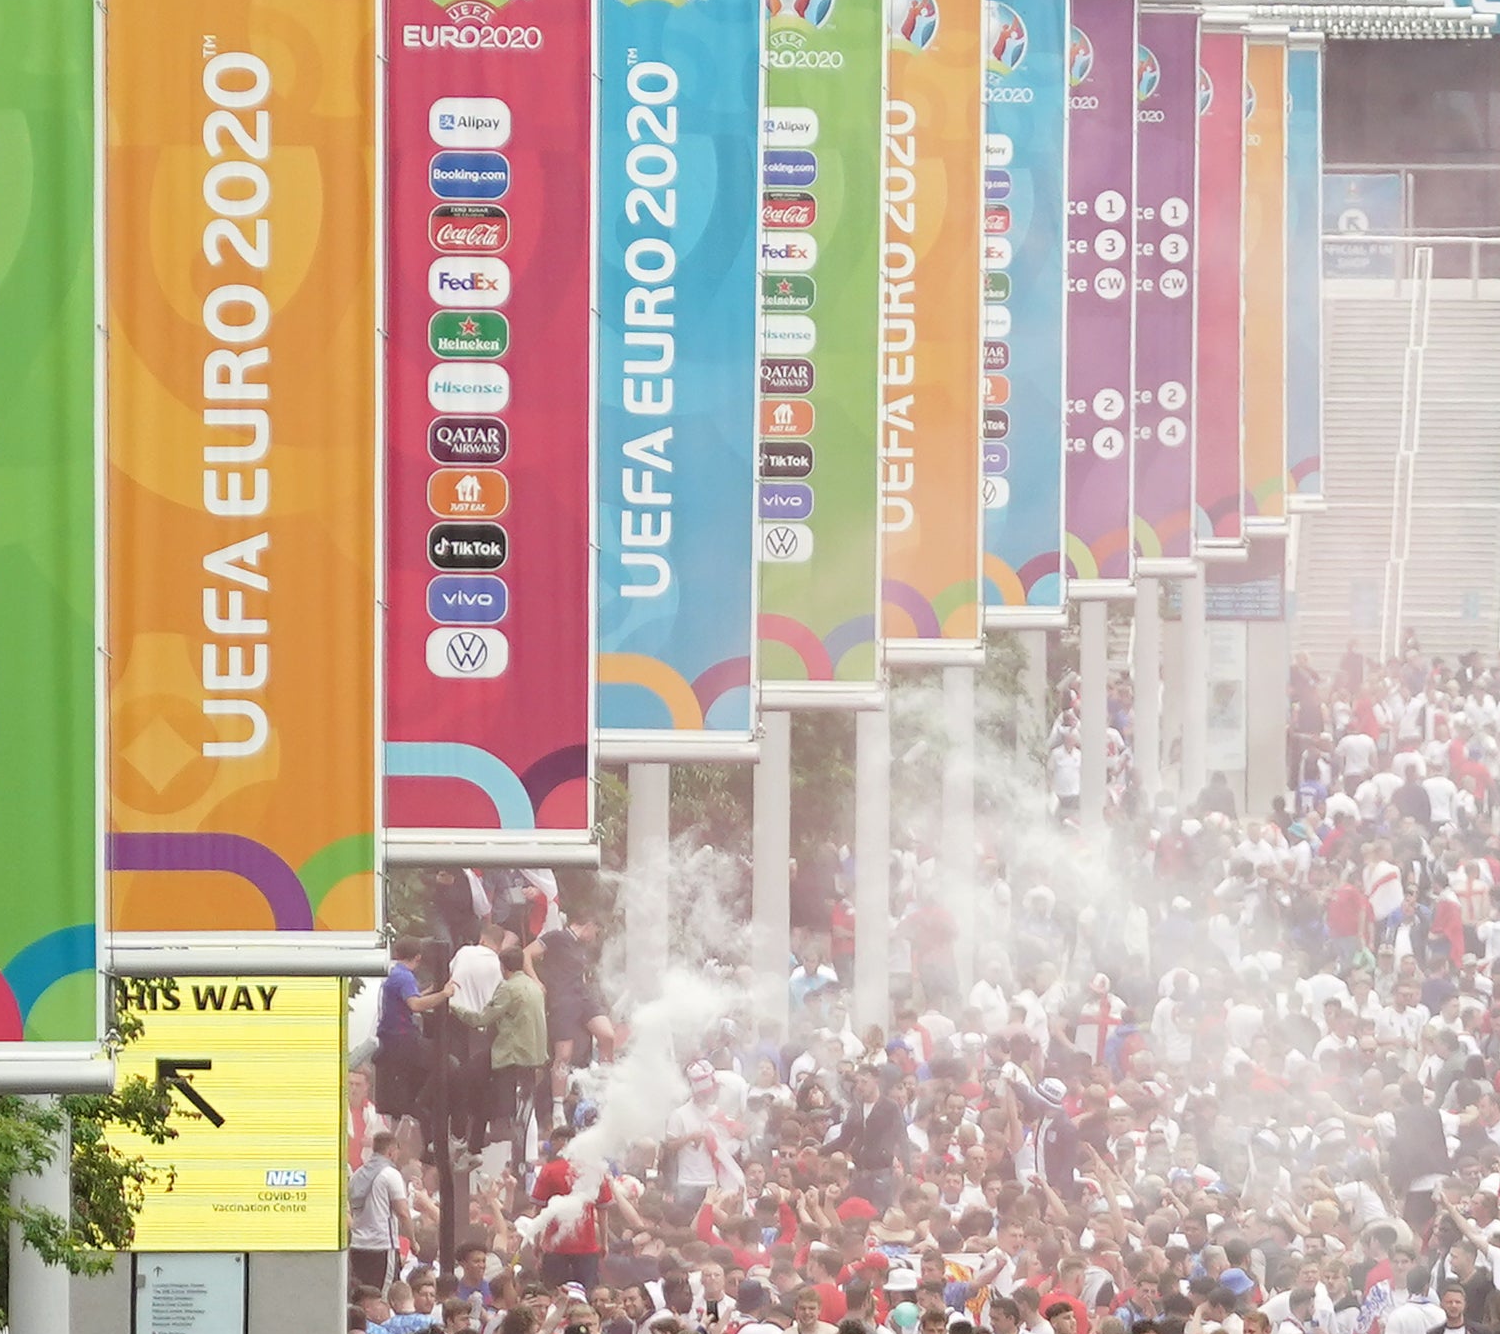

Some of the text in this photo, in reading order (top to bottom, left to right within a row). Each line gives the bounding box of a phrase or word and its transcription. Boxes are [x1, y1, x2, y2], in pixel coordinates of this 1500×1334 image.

[448, 4, 492, 22] UEFA
[457, 115, 500, 130] Alipay
[777, 120, 811, 133] Alipay
[432, 168, 506, 182] Booking.com
[762, 244, 808, 260] FedEx
[438, 272, 499, 291] FedEx
[619, 60, 680, 599] UEFA EURO 2020
[437, 337, 500, 352] Heineken
[433, 380, 503, 395] Hisense
[202, 51, 272, 760] UEFA EURO 2020
[436, 427, 500, 447] QATAR
[451, 443, 500, 455] AIRWAYS
[769, 455, 809, 468] TikTok
[763, 494, 803, 507] vivo
[450, 539, 501, 556] TikTok
[442, 589, 493, 606] vivo
[120, 985, 279, 1011] HIS WAY
[266, 1170, 307, 1186] NHS
[257, 1191, 307, 1202] COVID-19
[212, 1202, 307, 1213] Vaccination Centre
